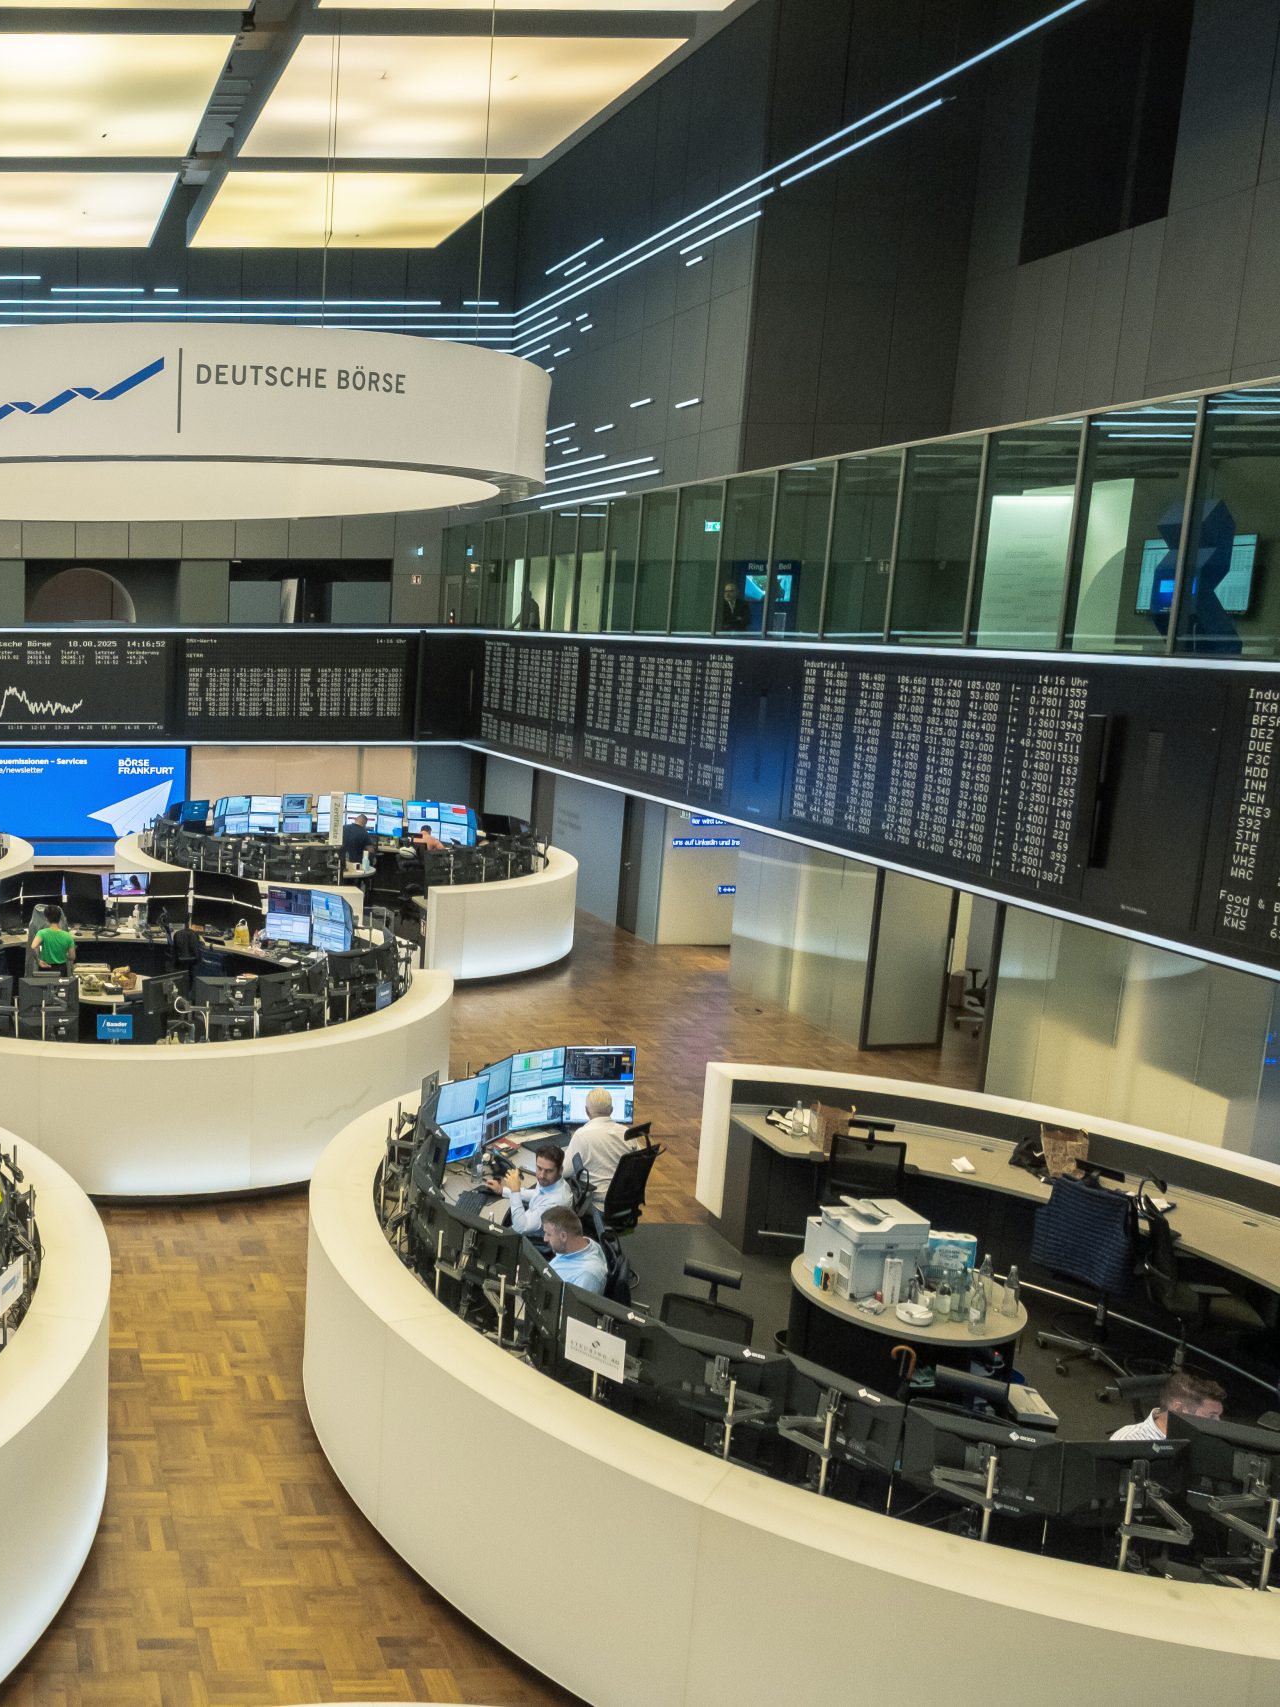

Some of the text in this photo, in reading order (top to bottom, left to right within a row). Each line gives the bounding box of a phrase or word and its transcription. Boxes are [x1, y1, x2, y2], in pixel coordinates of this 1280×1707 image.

[196, 363, 406, 394] DEUTSCHE BÖRSE
[748, 562, 764, 571] Ring
[27, 640, 52, 648] Börse
[68, 640, 118, 648] 18.08.2025
[127, 640, 166, 648] 14:16:52
[804, 660, 838, 670] Industrial
[1038, 675, 1065, 685] 14:16
[1071, 676, 1088, 687] Uhr
[967, 680, 1000, 691] 185,020
[1032, 685, 1059, 696] 1,840
[1065, 687, 1088, 698] 1559
[1249, 688, 1280, 700] Indu
[1069, 699, 1086, 709] 305
[1255, 702, 1278, 714] TKA
[1028, 706, 1084, 720] 0,410 794
[1028, 717, 1084, 732] 1,360 3943
[1026, 727, 1082, 743] 3,900 570
[1250, 727, 1275, 740] DEZ
[1020, 738, 1079, 754] 48,500 5111
[1248, 740, 1273, 753] DUE
[56, 757, 88, 765] Services
[118, 757, 150, 767] BÖRSE
[1024, 749, 1079, 765] 1,250 1539
[1246, 753, 1271, 765] F3C
[118, 766, 174, 775] FRANKFURT
[1023, 759, 1078, 776] 0,480 163
[1245, 766, 1269, 778] HDD
[1021, 769, 1076, 786] 0,300 137
[1020, 780, 1075, 798] 0,750 265
[1244, 779, 1267, 791] INH
[1019, 790, 1073, 808] 2,350 1297
[1241, 792, 1265, 804] JEN
[1239, 804, 1271, 819] PNE3
[1237, 817, 1261, 830] S92
[1235, 829, 1259, 843] STM
[1234, 841, 1257, 855] TPE
[1011, 852, 1066, 874] 5,500 73
[1232, 854, 1256, 868] VH2
[1010, 863, 1063, 885] 1,470 3871
[1230, 867, 1254, 881] WAC
[1219, 889, 1265, 910] Food &
[1225, 904, 1248, 918] SZU
[1223, 916, 1247, 931] KWS
